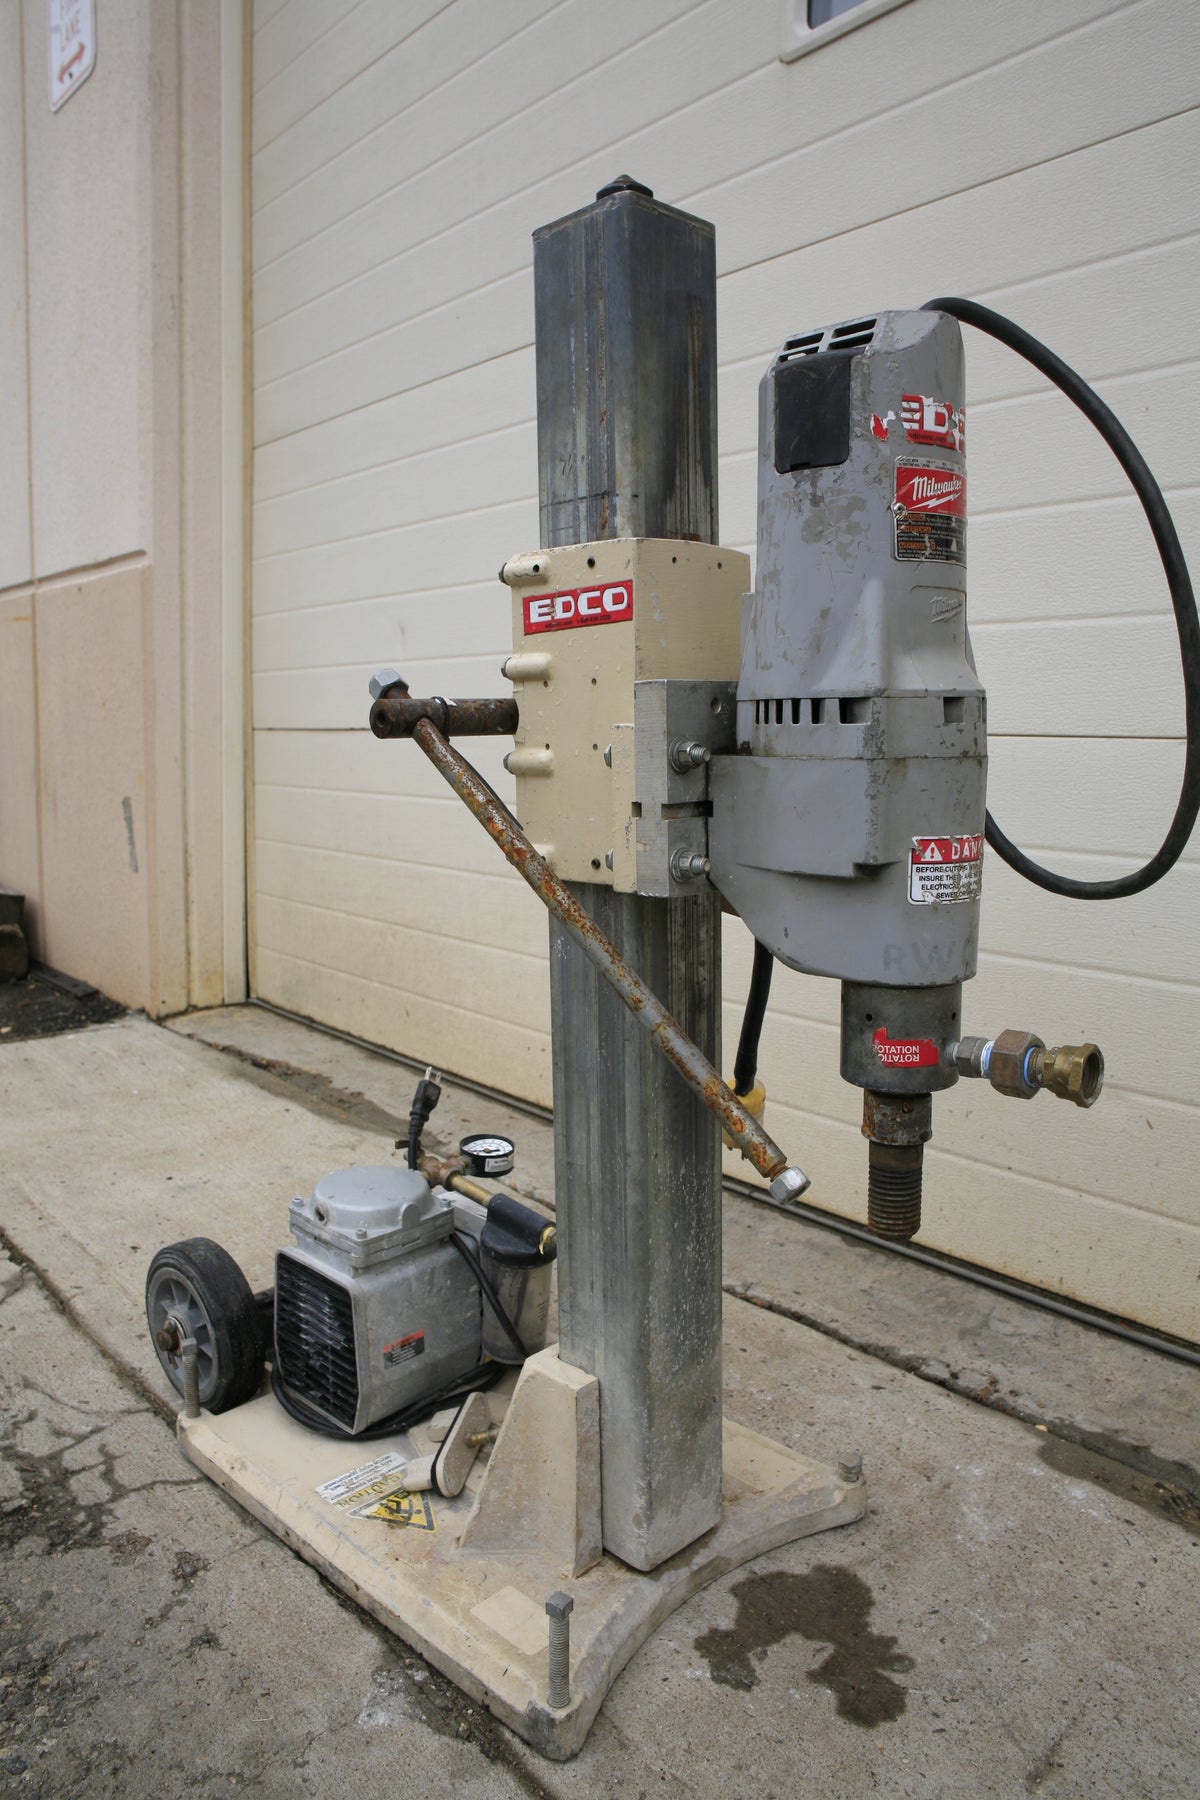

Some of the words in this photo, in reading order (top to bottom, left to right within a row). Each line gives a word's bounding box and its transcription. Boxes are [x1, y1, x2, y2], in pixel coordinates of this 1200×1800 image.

[529, 586, 628, 624] EDCO
[875, 1044, 919, 1054] OTATION
[878, 1053, 919, 1062] ROTATIO
